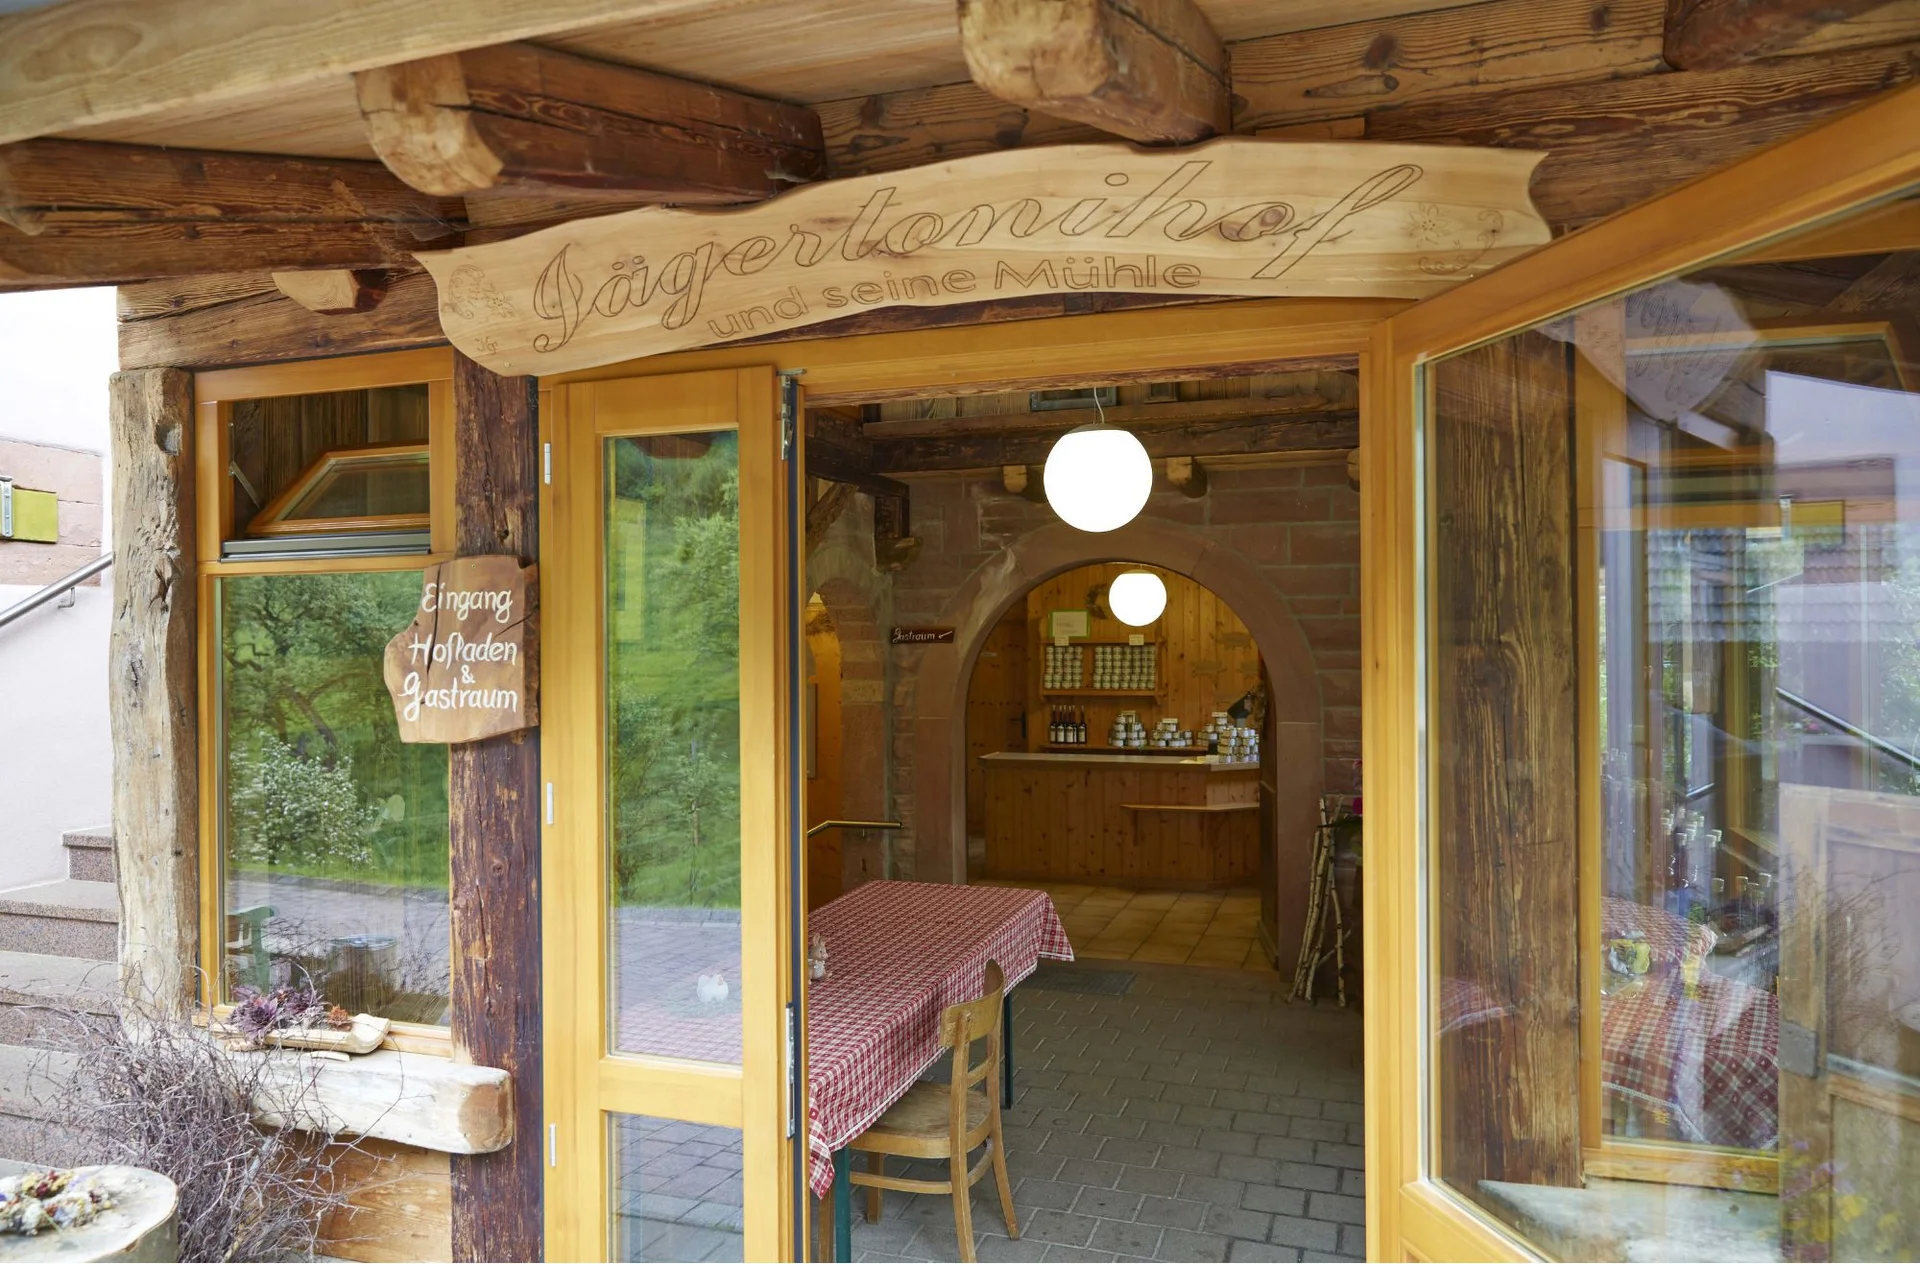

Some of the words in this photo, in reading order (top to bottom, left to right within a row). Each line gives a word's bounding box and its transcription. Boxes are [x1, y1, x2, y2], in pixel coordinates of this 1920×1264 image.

[532, 159, 1425, 354] Jägertonihof
[706, 286, 810, 340] und
[821, 271, 977, 309] seine
[993, 254, 1201, 290] Mühle
[421, 582, 513, 623] Eingang
[408, 631, 517, 670] Hofladen
[398, 671, 518, 722] Gastraum
[461, 664, 475, 684] &
